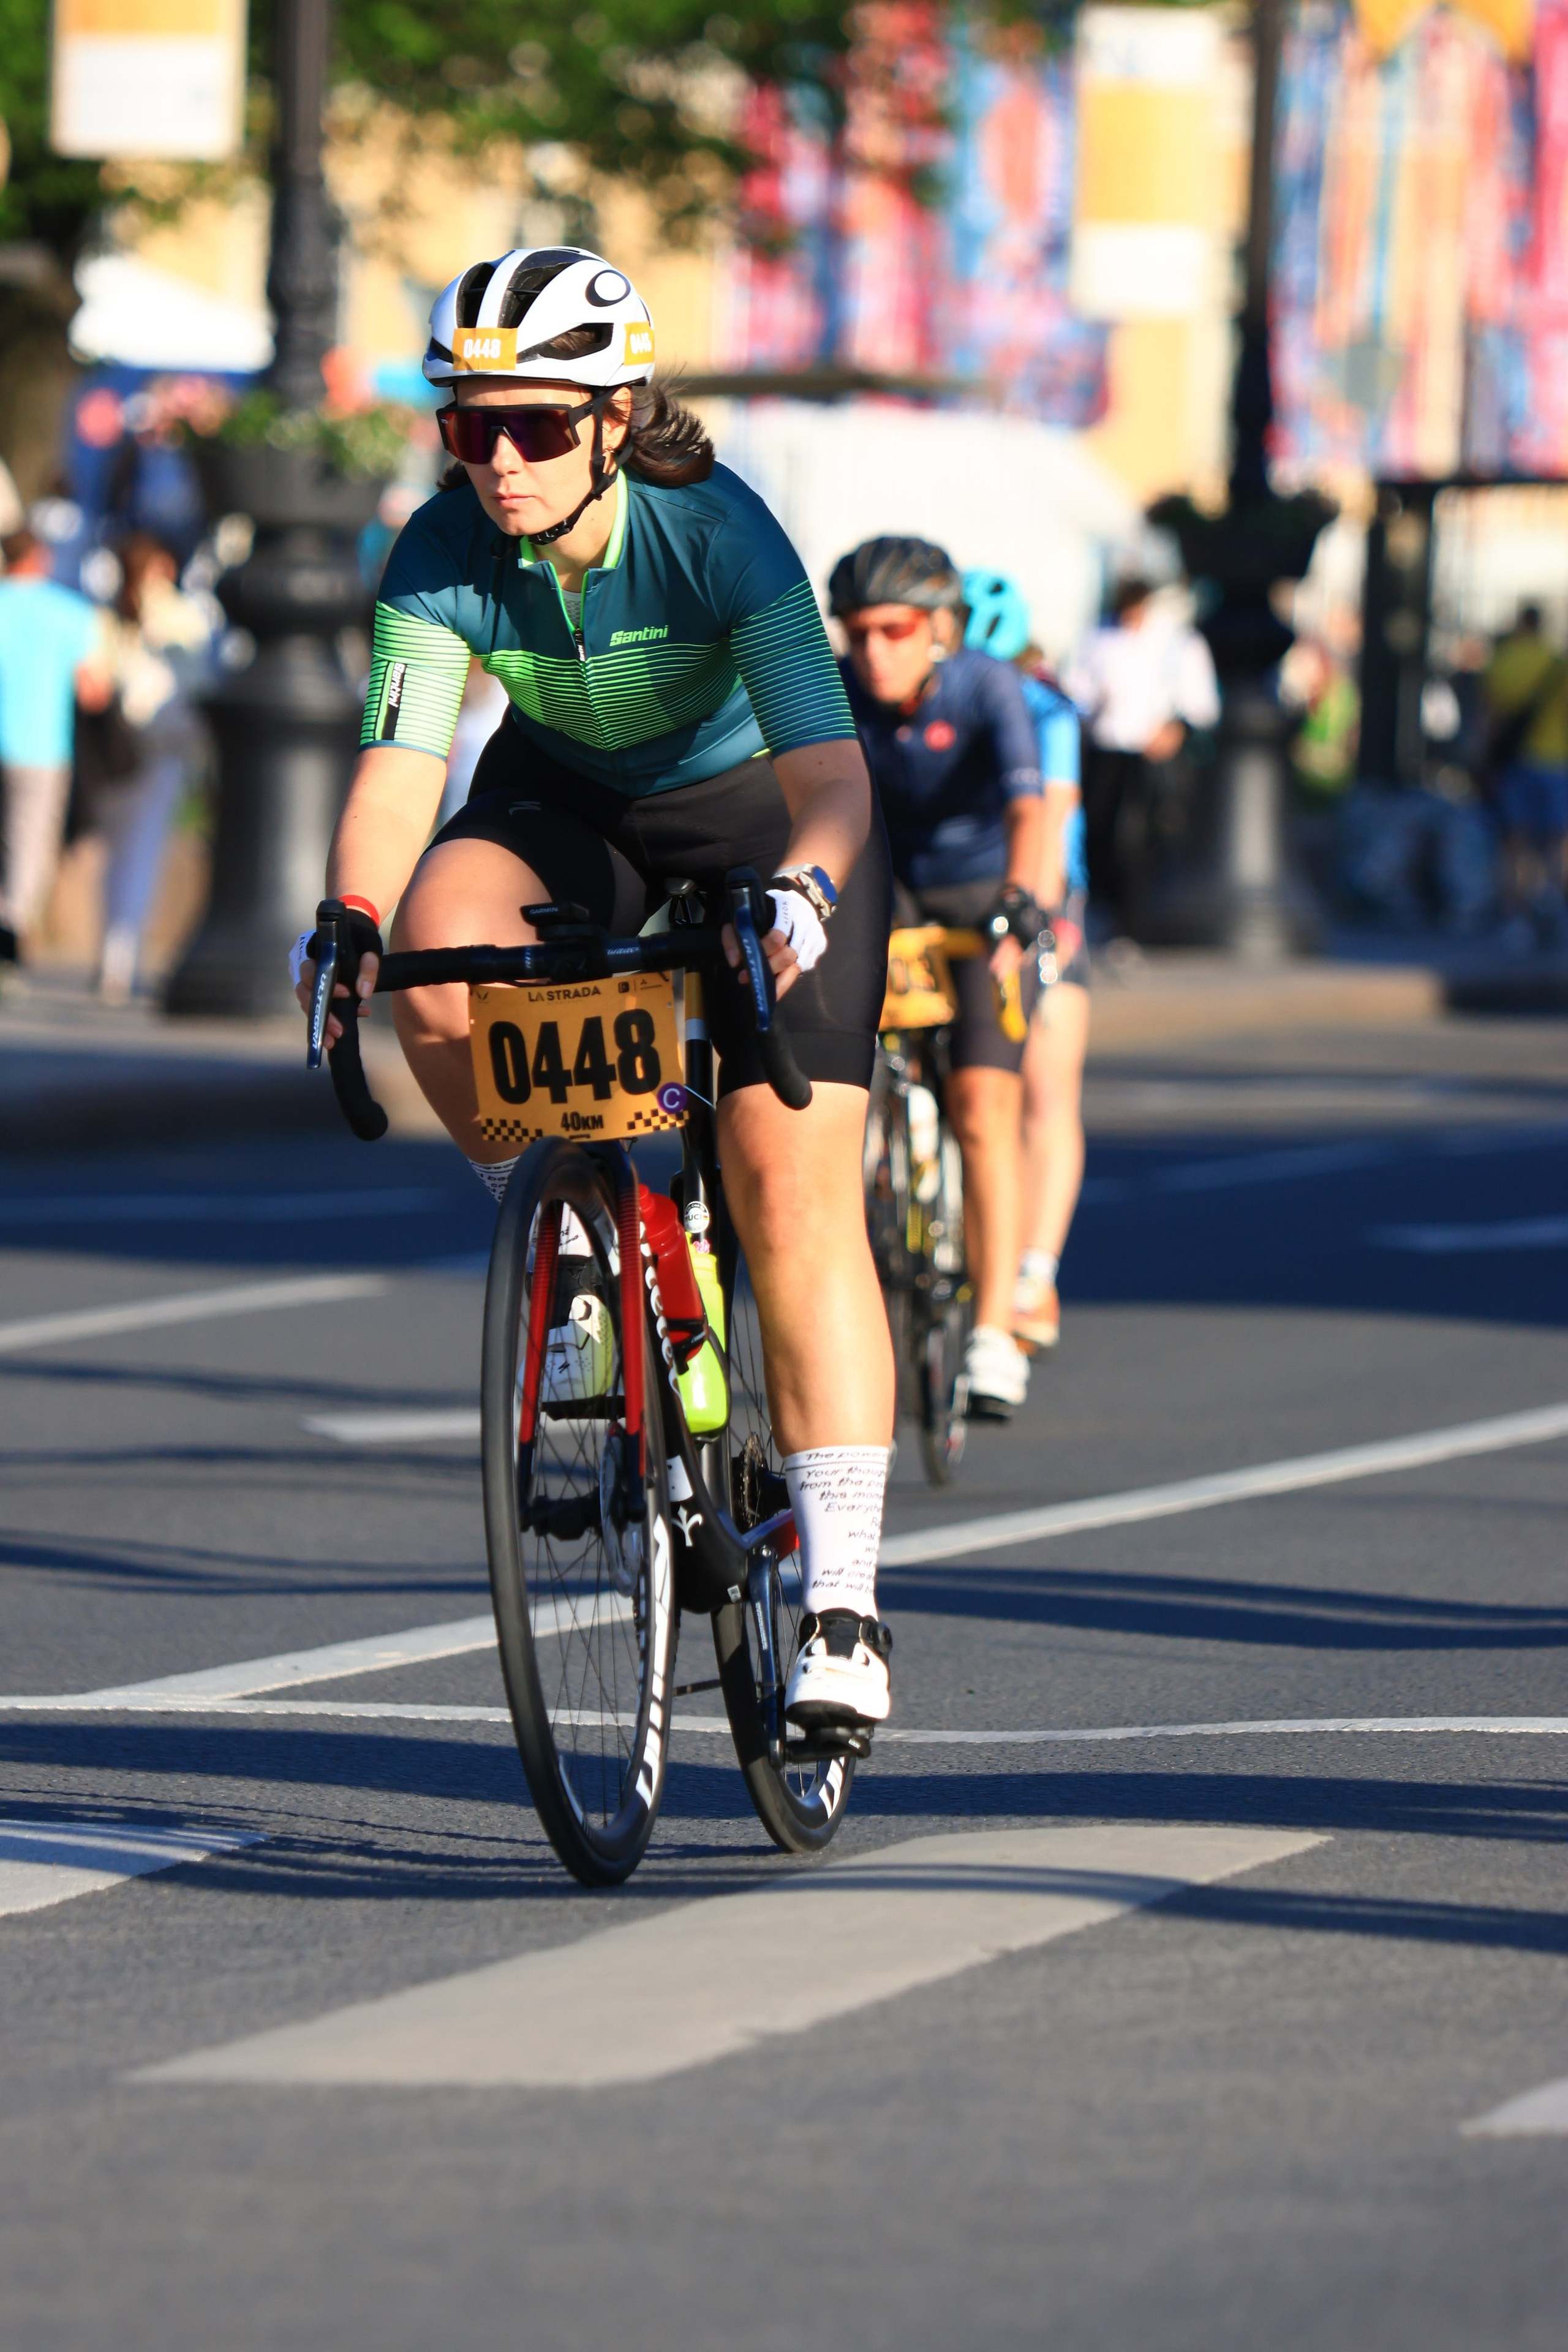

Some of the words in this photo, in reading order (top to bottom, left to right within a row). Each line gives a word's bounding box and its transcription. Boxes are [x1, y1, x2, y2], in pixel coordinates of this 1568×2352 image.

[463, 338, 502, 359] 0448
[609, 625, 669, 647] Santini
[388, 662, 405, 708] Santini
[530, 907, 559, 915] GARMIN
[528, 991, 545, 1003] LA
[547, 985, 601, 1001] STRADA
[312, 973, 326, 1049] ULTEGRA
[488, 1008, 662, 1104] 0448
[663, 1088, 681, 1109] C
[800, 1481, 831, 1491] from
